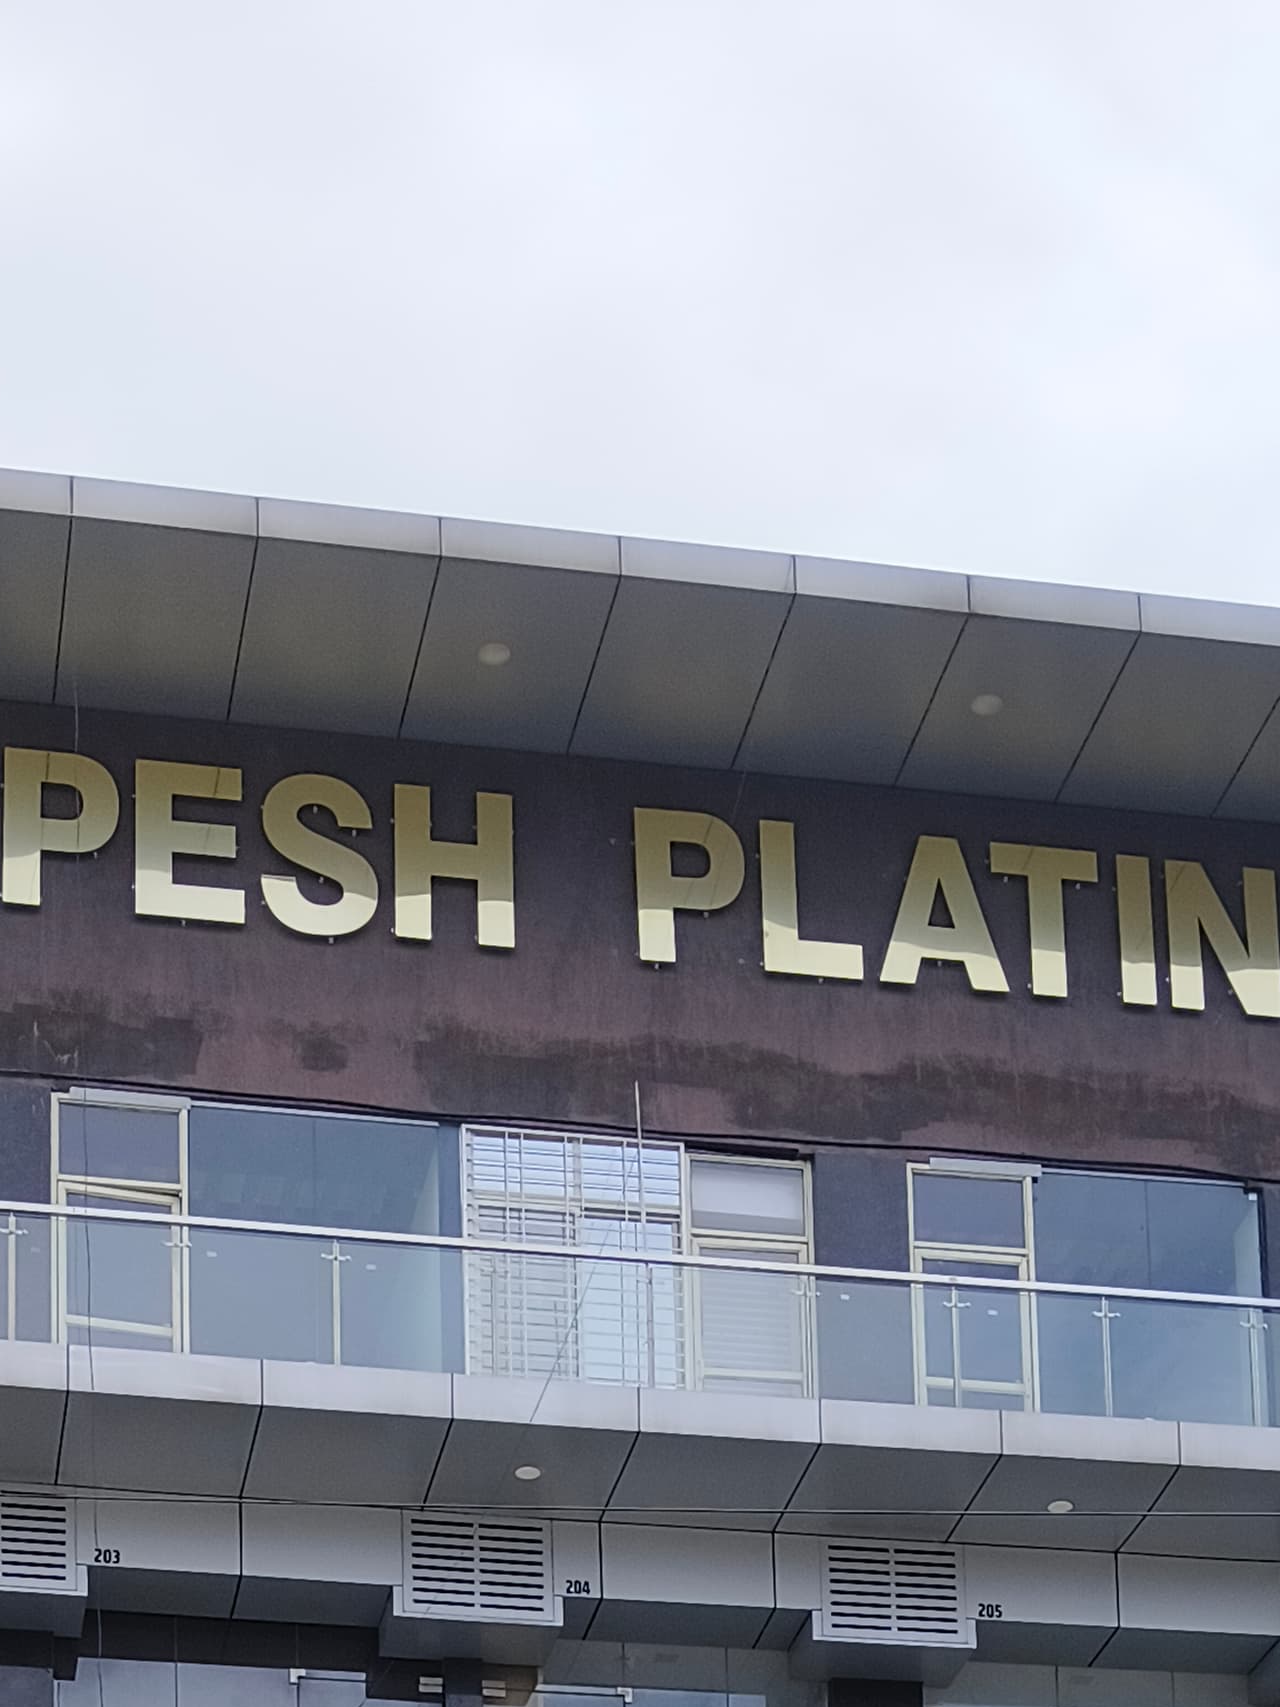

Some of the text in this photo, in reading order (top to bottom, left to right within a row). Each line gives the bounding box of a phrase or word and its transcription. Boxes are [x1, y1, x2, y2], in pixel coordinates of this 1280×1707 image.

[1, 746, 517, 949] PESH
[93, 1547, 120, 1565] 203
[565, 1579, 591, 1596] 204
[978, 1602, 1003, 1620] 205
